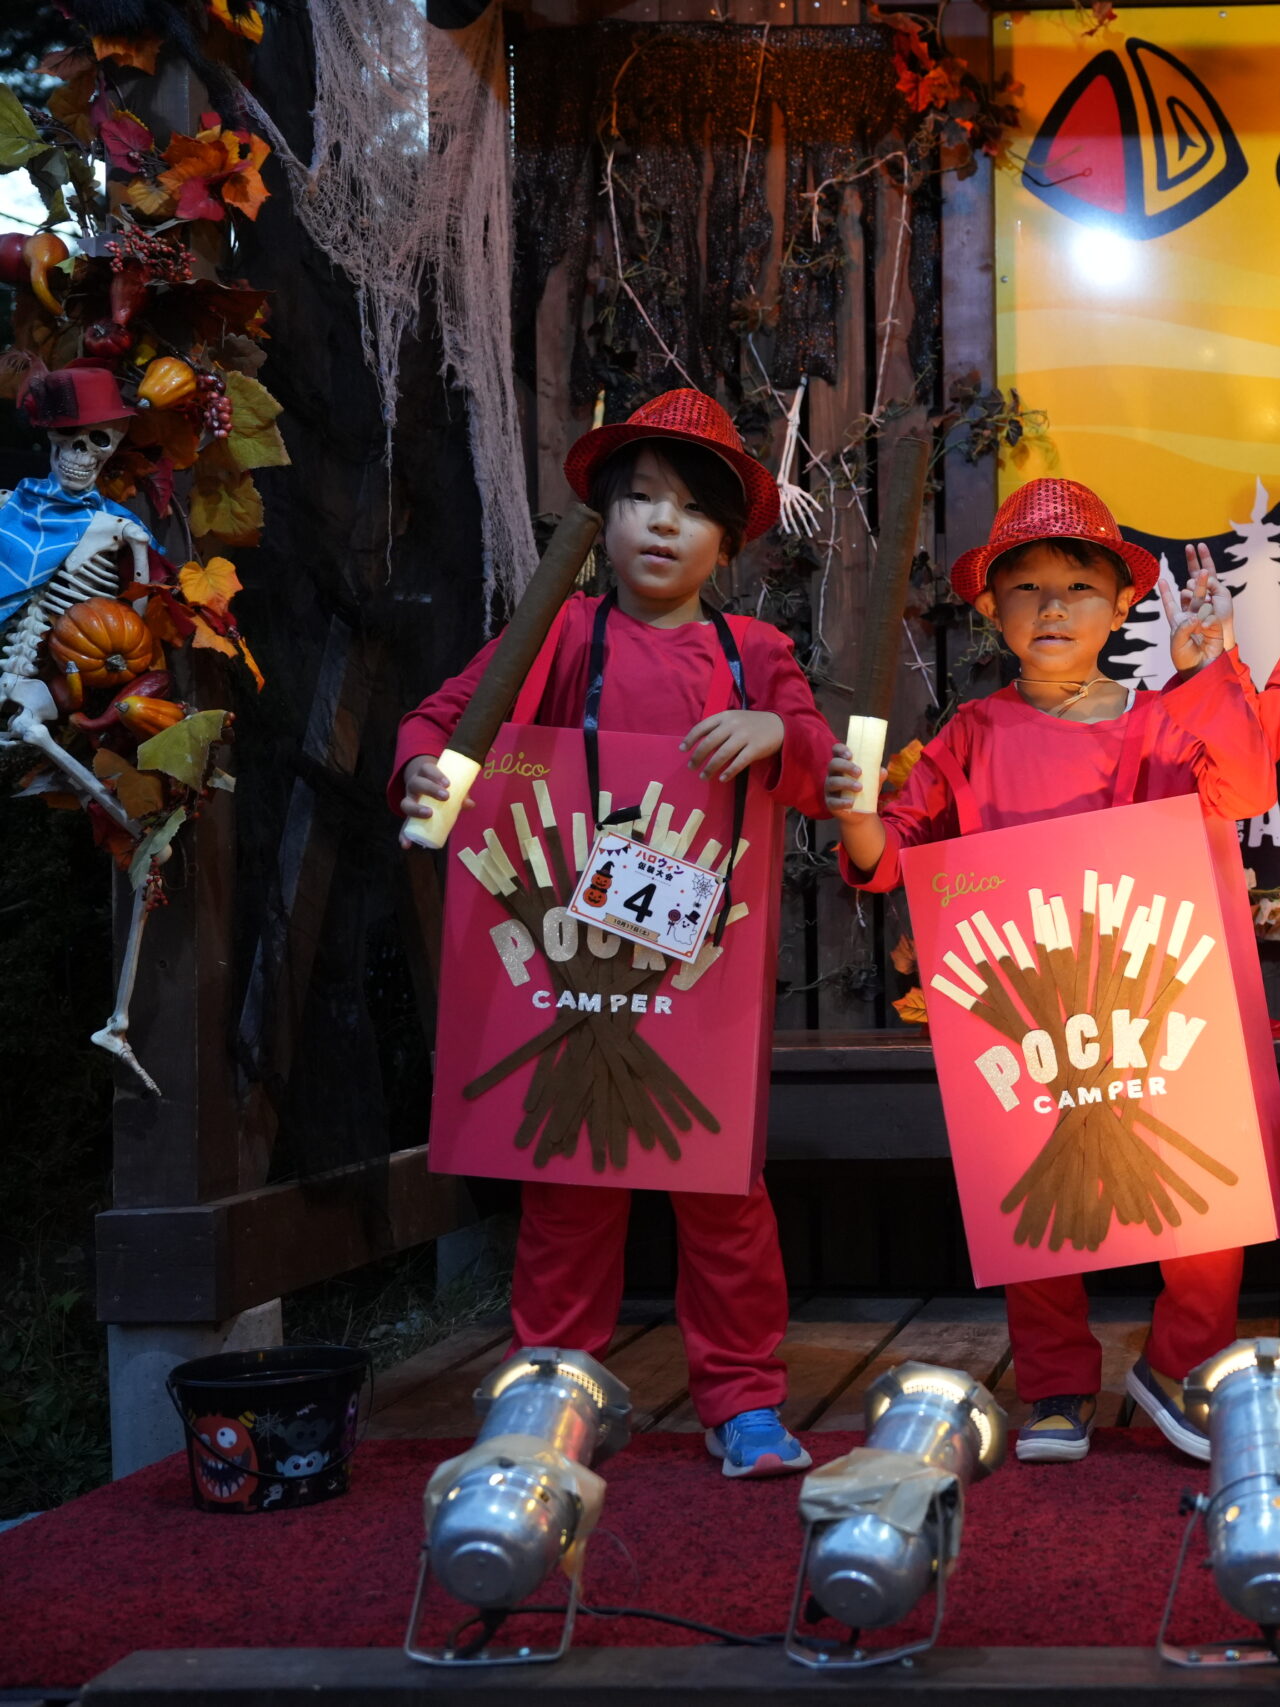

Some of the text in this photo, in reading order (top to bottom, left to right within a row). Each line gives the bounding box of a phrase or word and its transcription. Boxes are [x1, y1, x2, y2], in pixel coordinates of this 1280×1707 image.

[636, 850, 684, 875] ハロウィン
[638, 861, 673, 881] 仮装大会
[623, 883, 657, 923] 4
[932, 872, 1006, 907] Glico
[532, 990, 672, 1014] CAMPER
[1033, 1077, 1167, 1114] CAMPER
